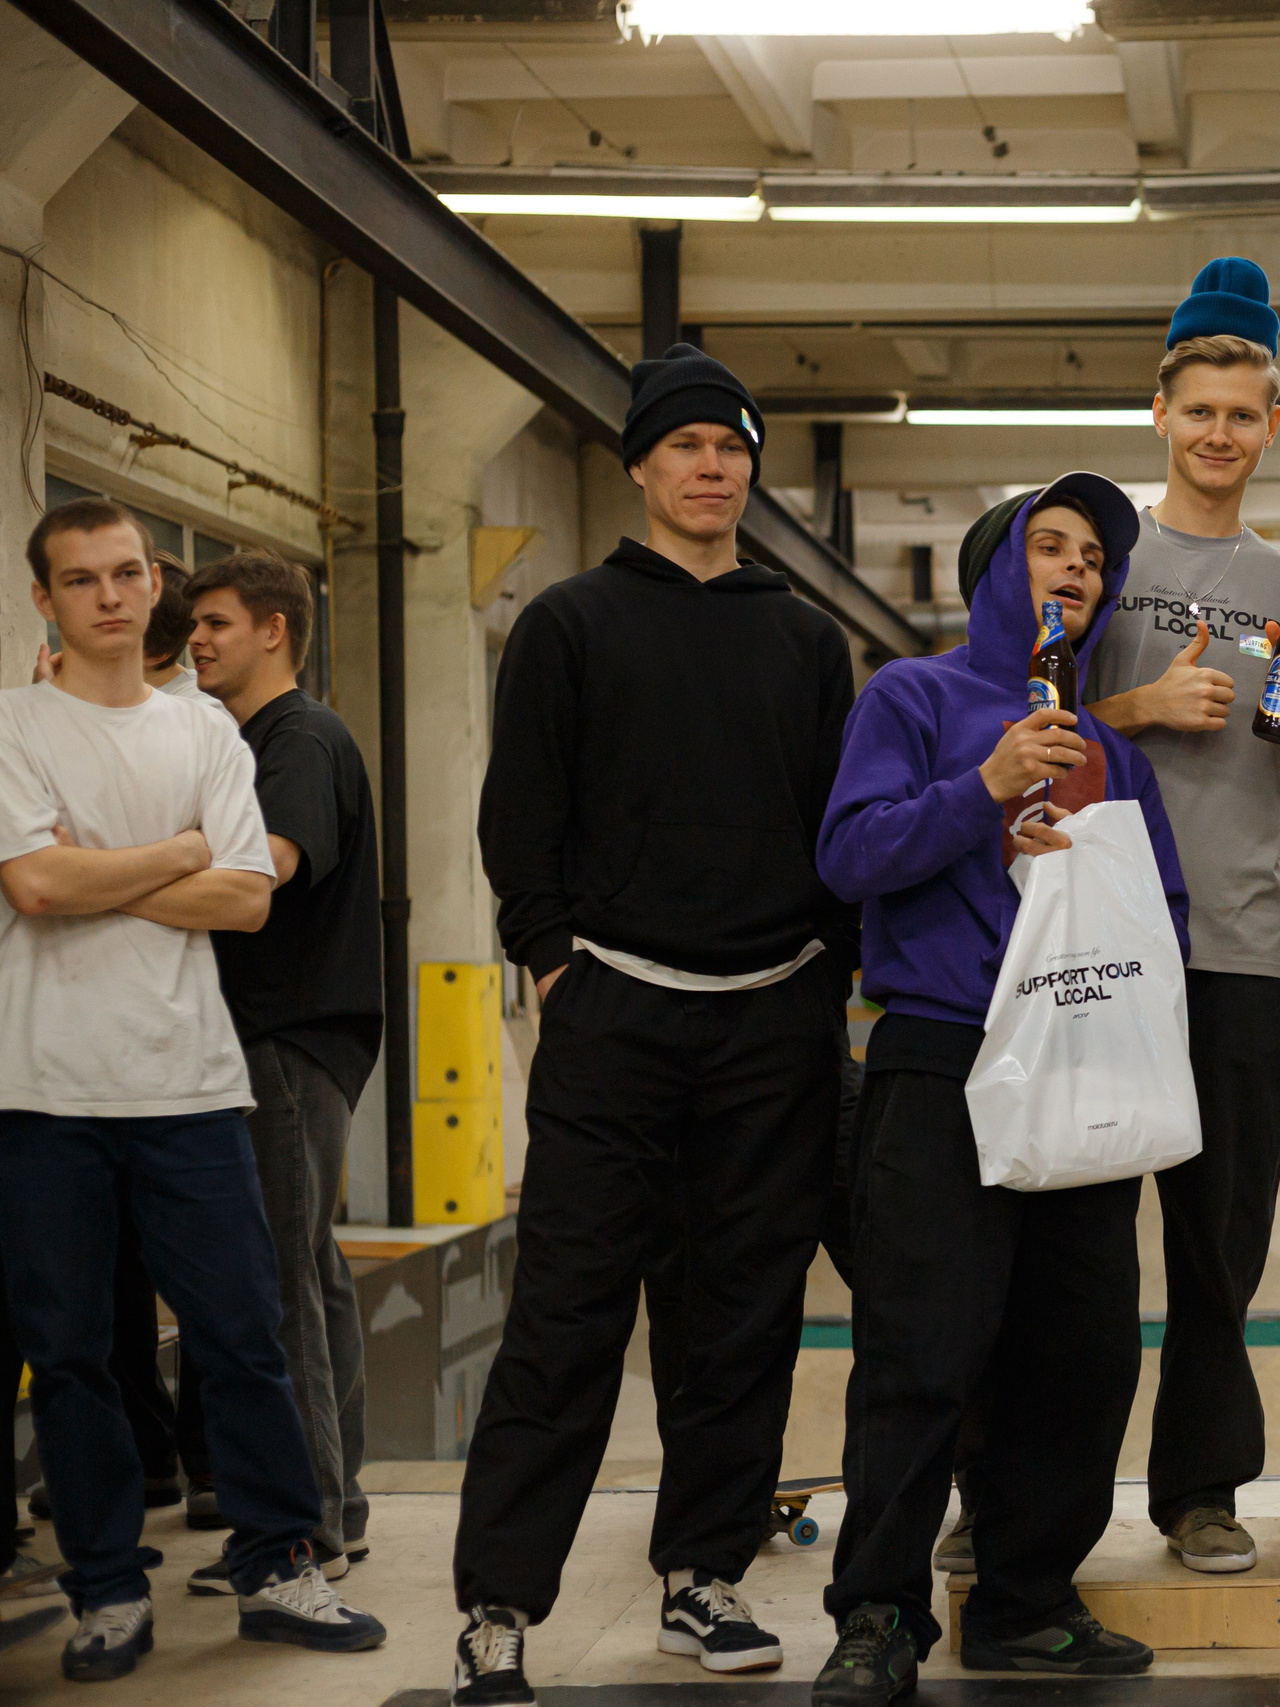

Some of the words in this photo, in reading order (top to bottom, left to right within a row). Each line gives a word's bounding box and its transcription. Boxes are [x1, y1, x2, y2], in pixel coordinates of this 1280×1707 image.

[1185, 590, 1231, 605] Woldwide
[1154, 615, 1234, 641] LOCAL
[1015, 966, 1090, 999] SUPPORT
[1091, 961, 1143, 983] YOUR
[1054, 984, 1112, 1007] LOCAL
